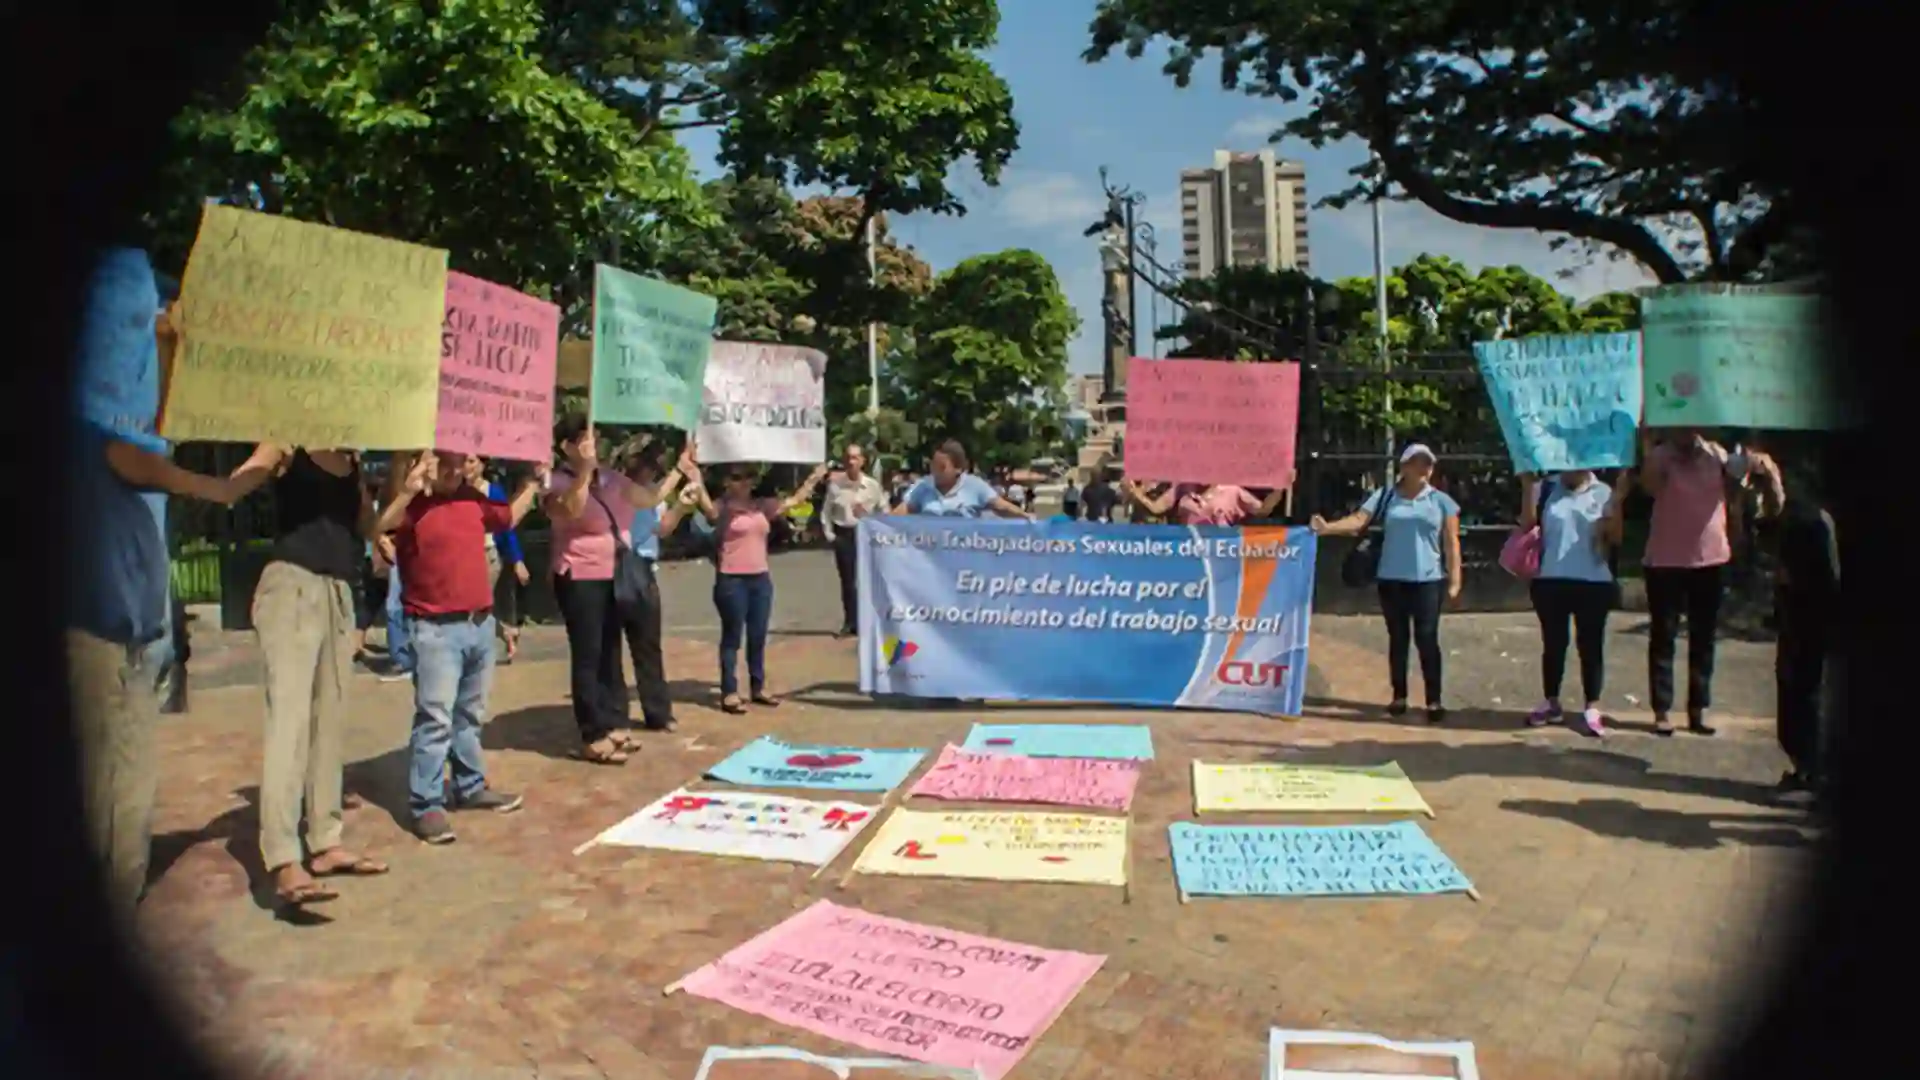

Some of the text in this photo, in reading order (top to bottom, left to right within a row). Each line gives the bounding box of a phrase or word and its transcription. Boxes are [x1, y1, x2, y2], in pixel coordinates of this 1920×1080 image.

[942, 529, 1076, 555] Trabajadoras
[1081, 535, 1174, 557] Sexuales
[1179, 537, 1210, 558] del
[1216, 539, 1300, 560] Ecuador
[955, 569, 1209, 602] En pie de lucha por el
[1068, 605, 1106, 631] del
[1110, 609, 1199, 636] trabajo
[1201, 612, 1284, 635] sexual
[1217, 661, 1289, 688] CUT
